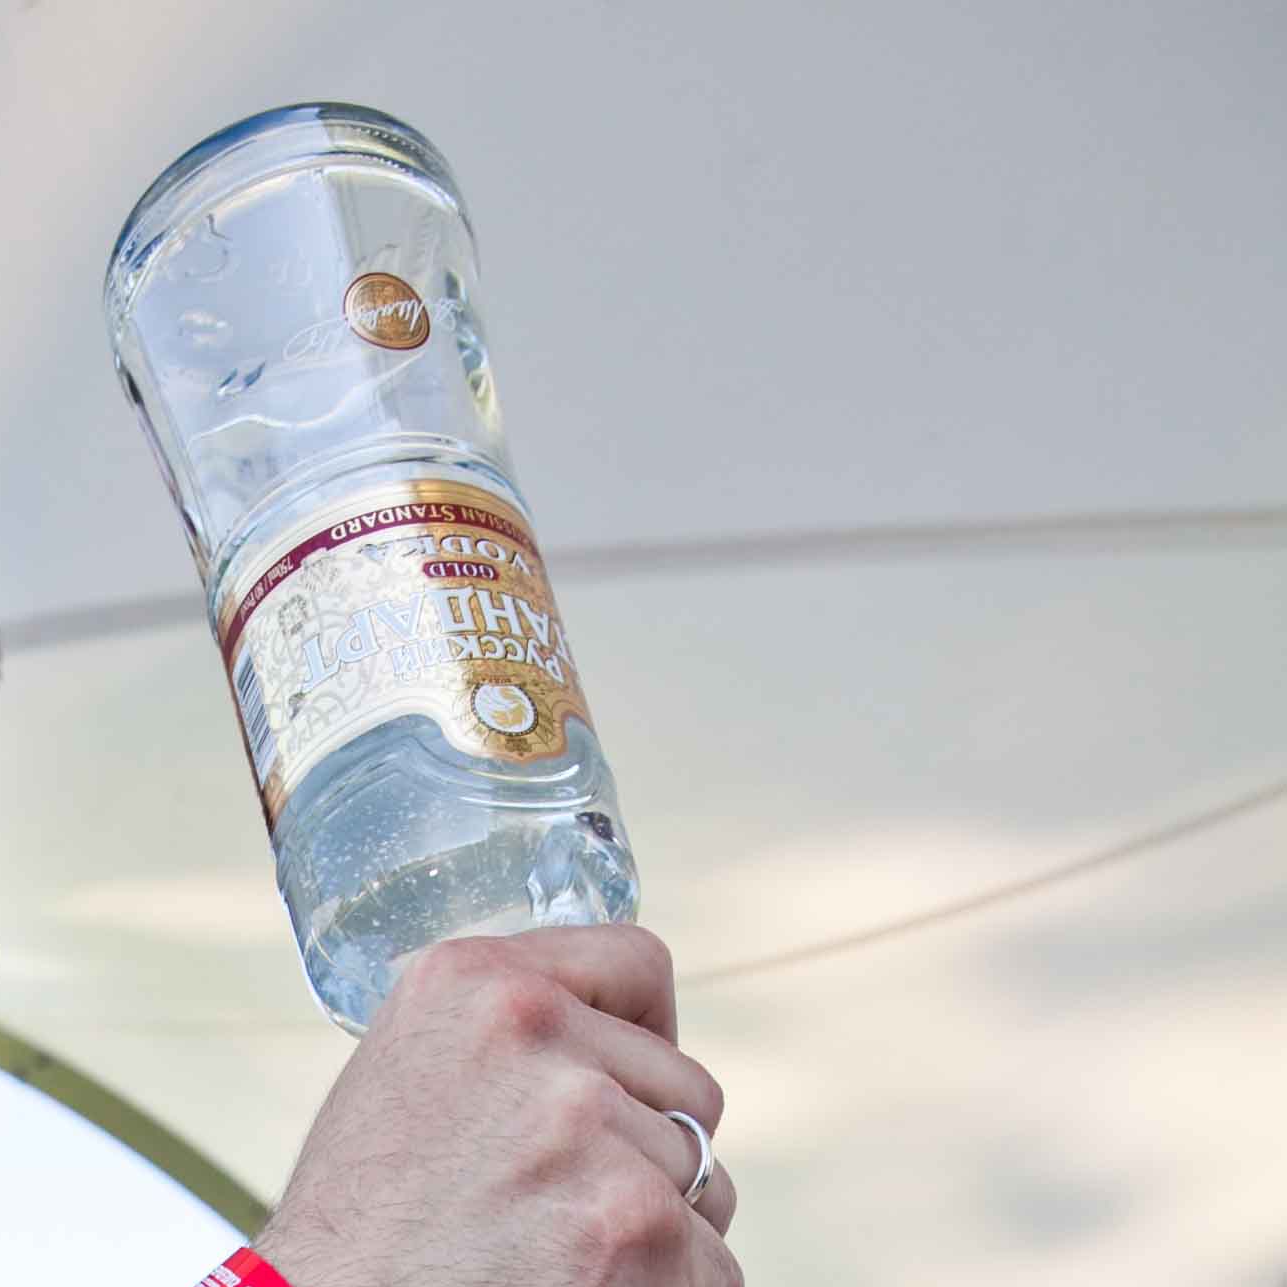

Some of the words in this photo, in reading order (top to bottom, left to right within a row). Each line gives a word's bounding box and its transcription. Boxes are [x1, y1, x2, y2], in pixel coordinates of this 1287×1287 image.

[330, 504, 456, 541] STANDARD
[358, 533, 532, 577] VODKA
[428, 562, 494, 580] GOLD
